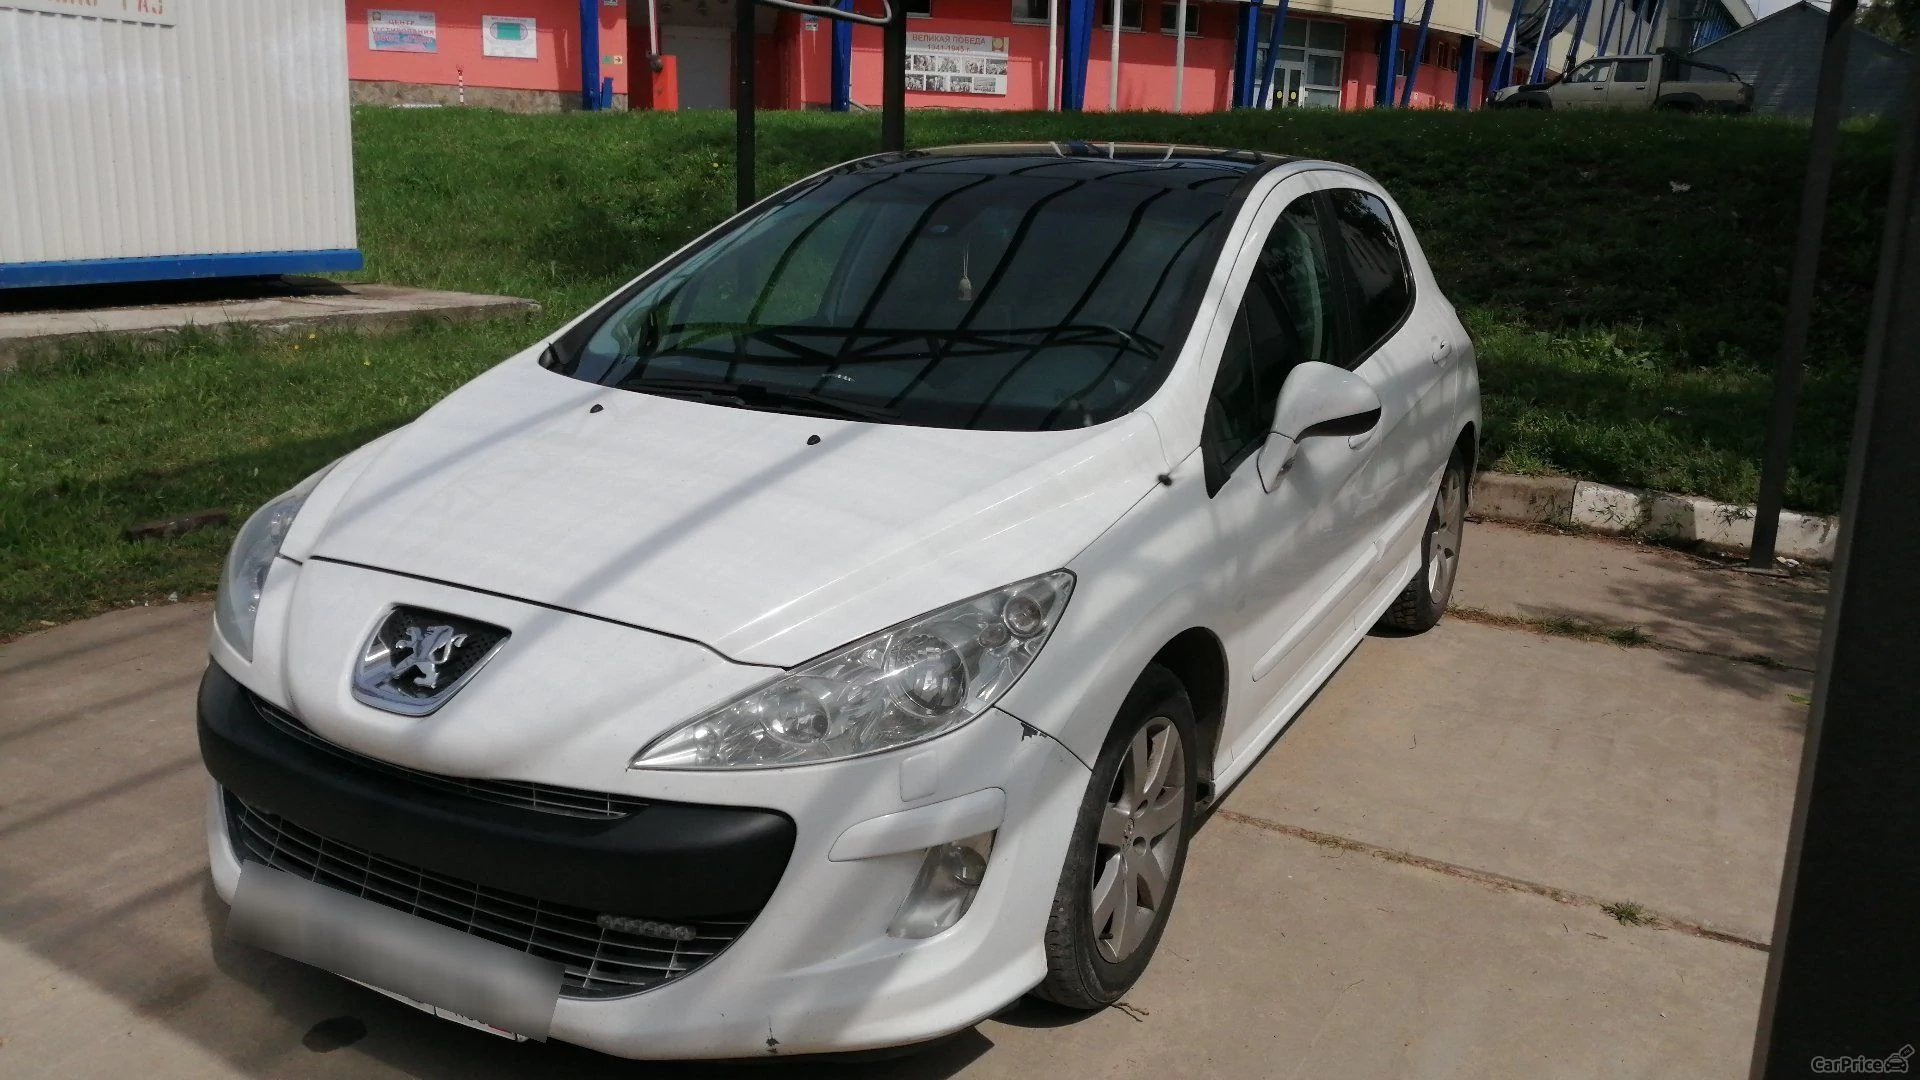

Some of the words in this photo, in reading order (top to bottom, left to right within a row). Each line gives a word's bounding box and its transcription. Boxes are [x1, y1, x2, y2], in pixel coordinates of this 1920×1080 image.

[912, 34, 950, 43] ВЕЛИКАЯ
[953, 36, 986, 45] ПОБЕДА
[927, 44, 964, 52] 1941-1945
